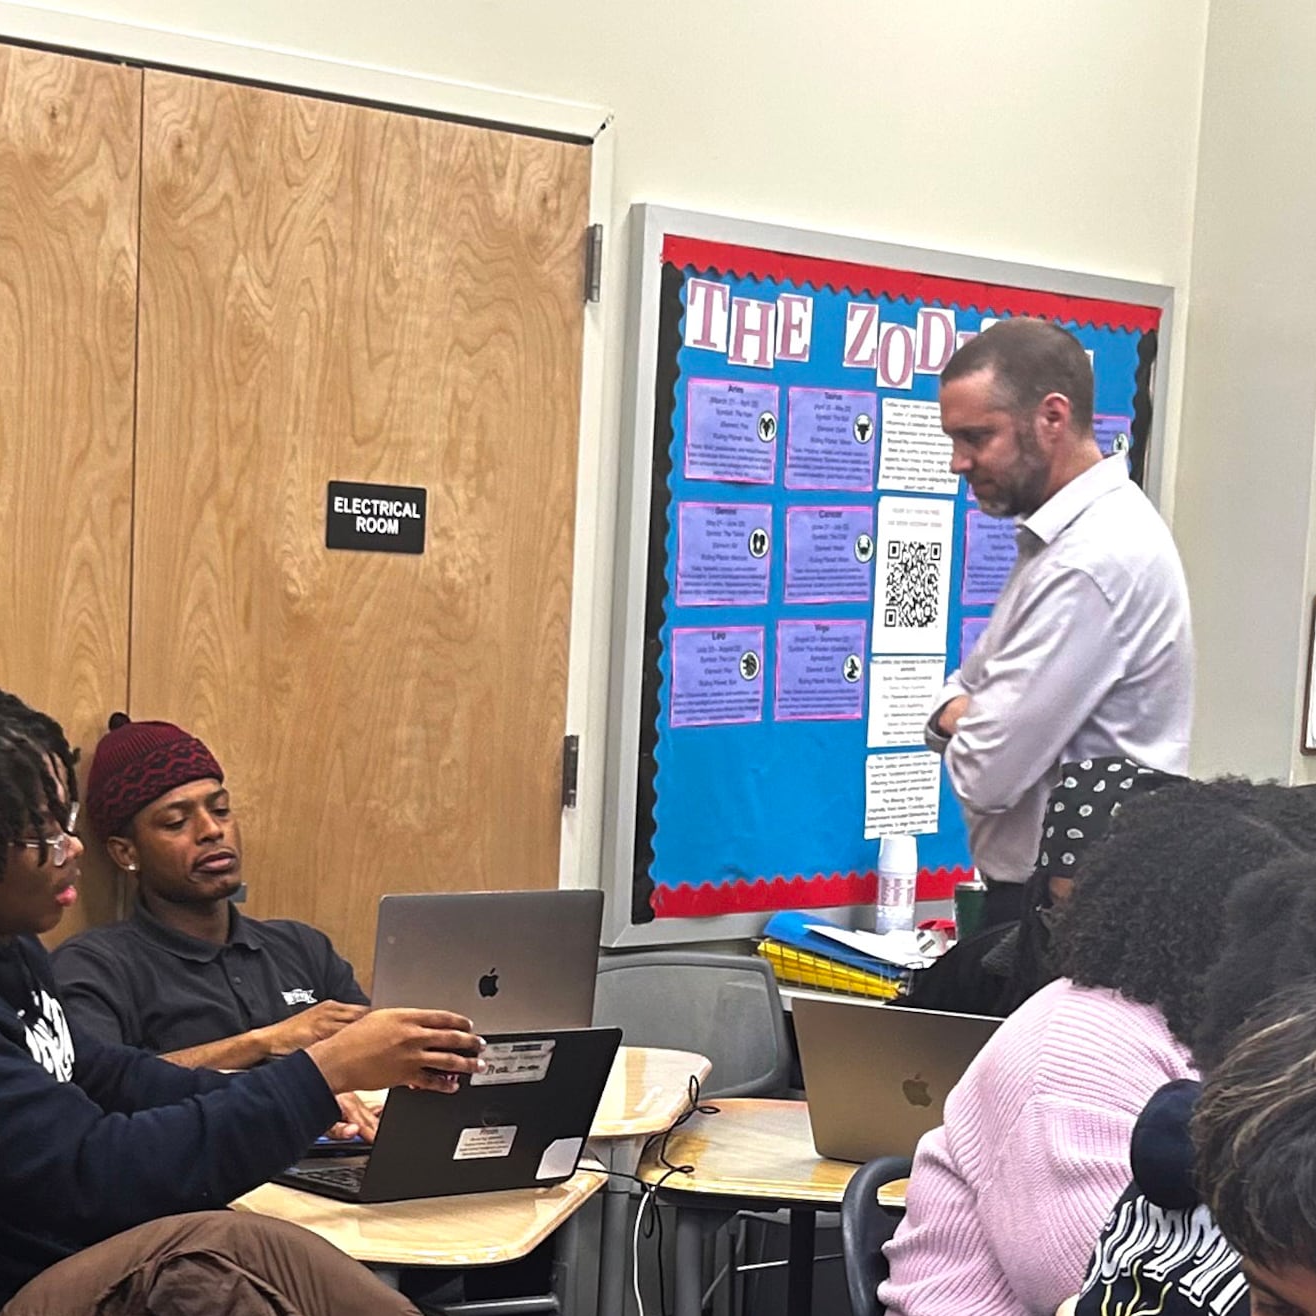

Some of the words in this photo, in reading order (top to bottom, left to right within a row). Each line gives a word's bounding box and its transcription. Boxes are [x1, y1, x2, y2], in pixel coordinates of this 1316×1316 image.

[690, 280, 809, 367] THE
[845, 304, 978, 387] ZOD
[334, 496, 420, 519] ELECTRICAL
[355, 516, 399, 535] ROOM
